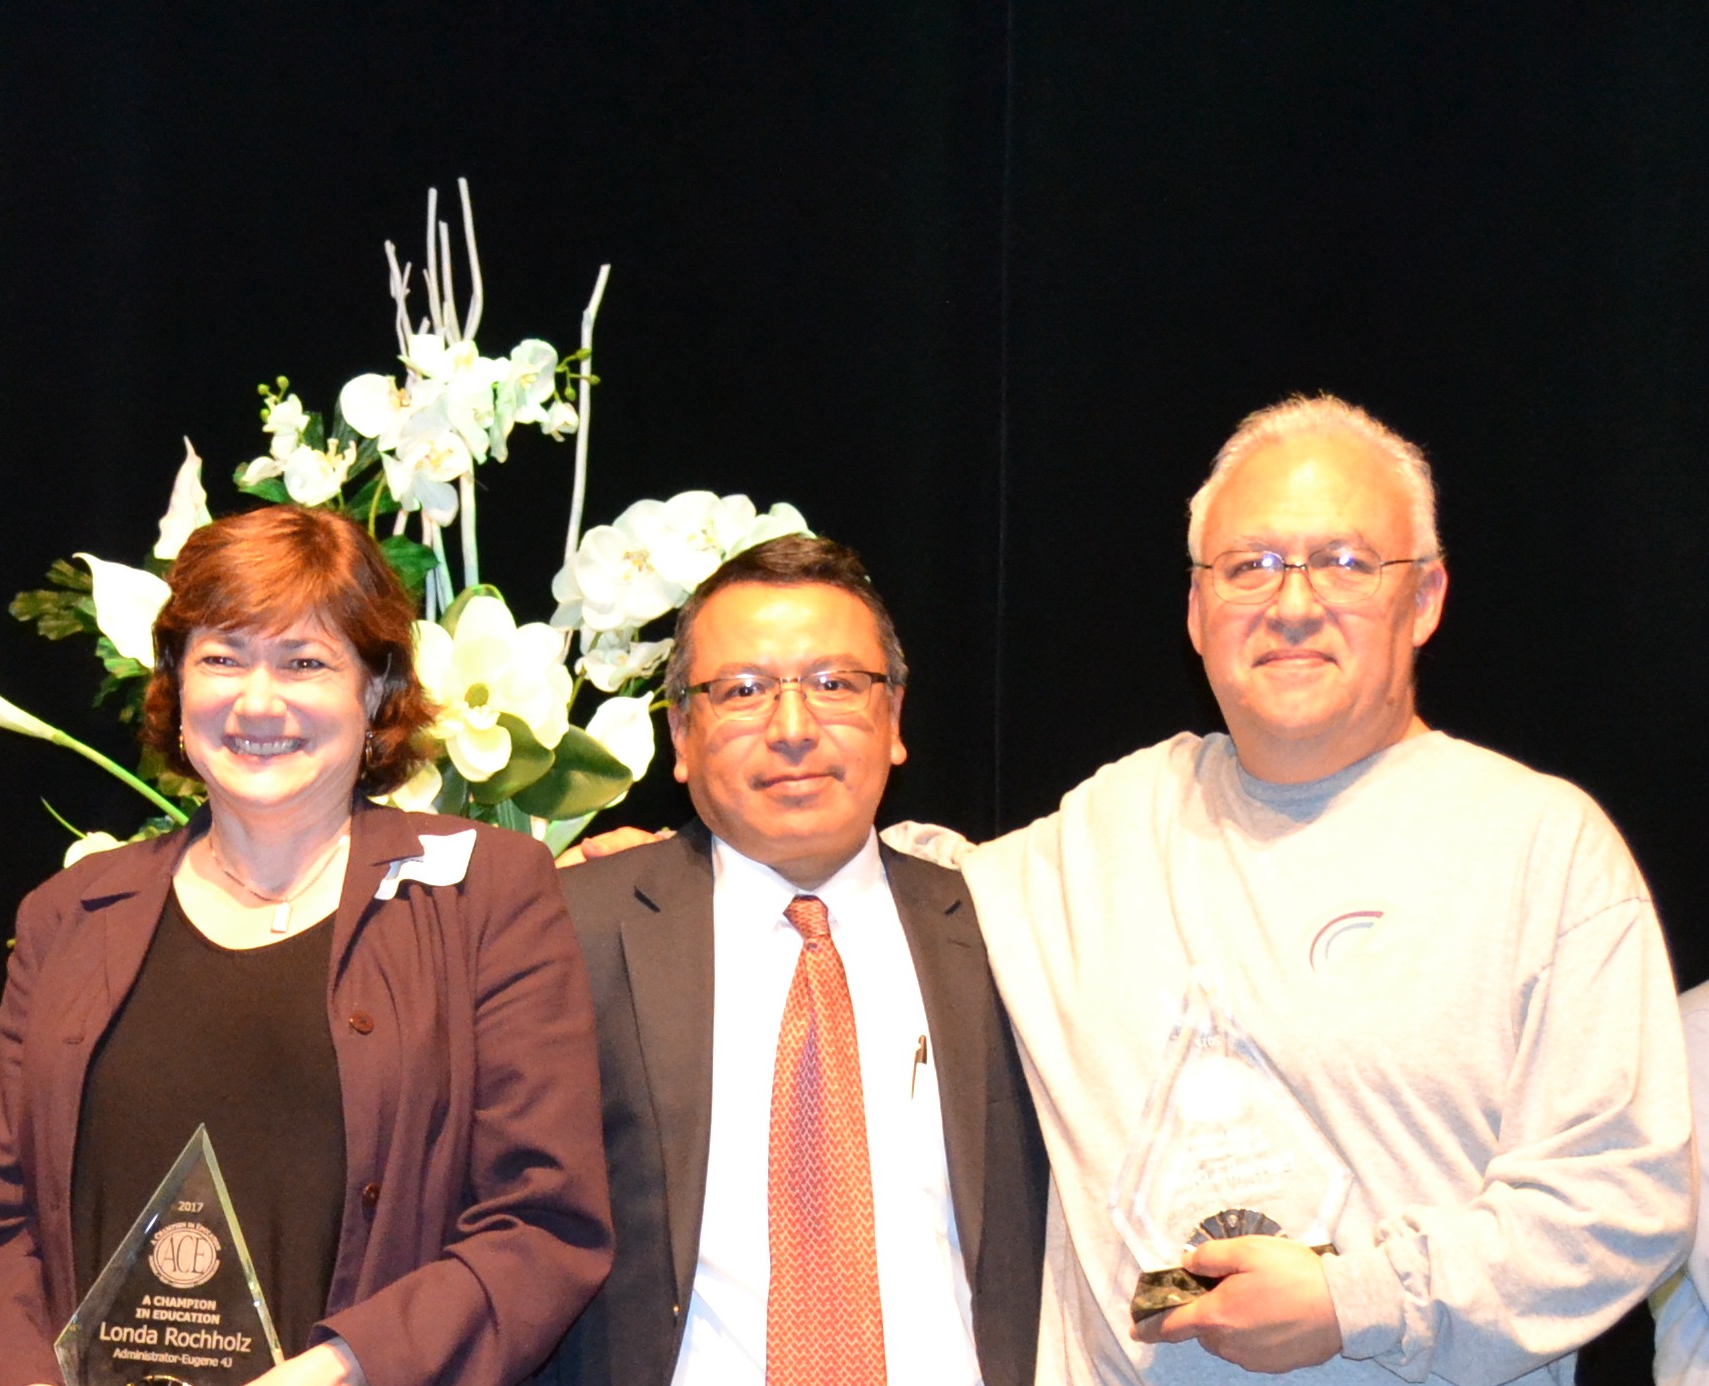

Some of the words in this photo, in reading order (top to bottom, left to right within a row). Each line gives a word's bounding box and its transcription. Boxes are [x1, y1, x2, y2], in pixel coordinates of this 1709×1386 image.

[179, 1201, 204, 1213] 2017
[162, 1234, 206, 1275] ACE
[142, 1295, 151, 1305] A
[154, 1296, 217, 1311] CHAMPION
[135, 1308, 150, 1319] IN
[153, 1309, 220, 1324] EDUCATION
[100, 1322, 158, 1344] Londa
[165, 1327, 252, 1352] Rochholz
[113, 1348, 219, 1367] Administrator-Eugene
[220, 1357, 233, 1368] 4J
